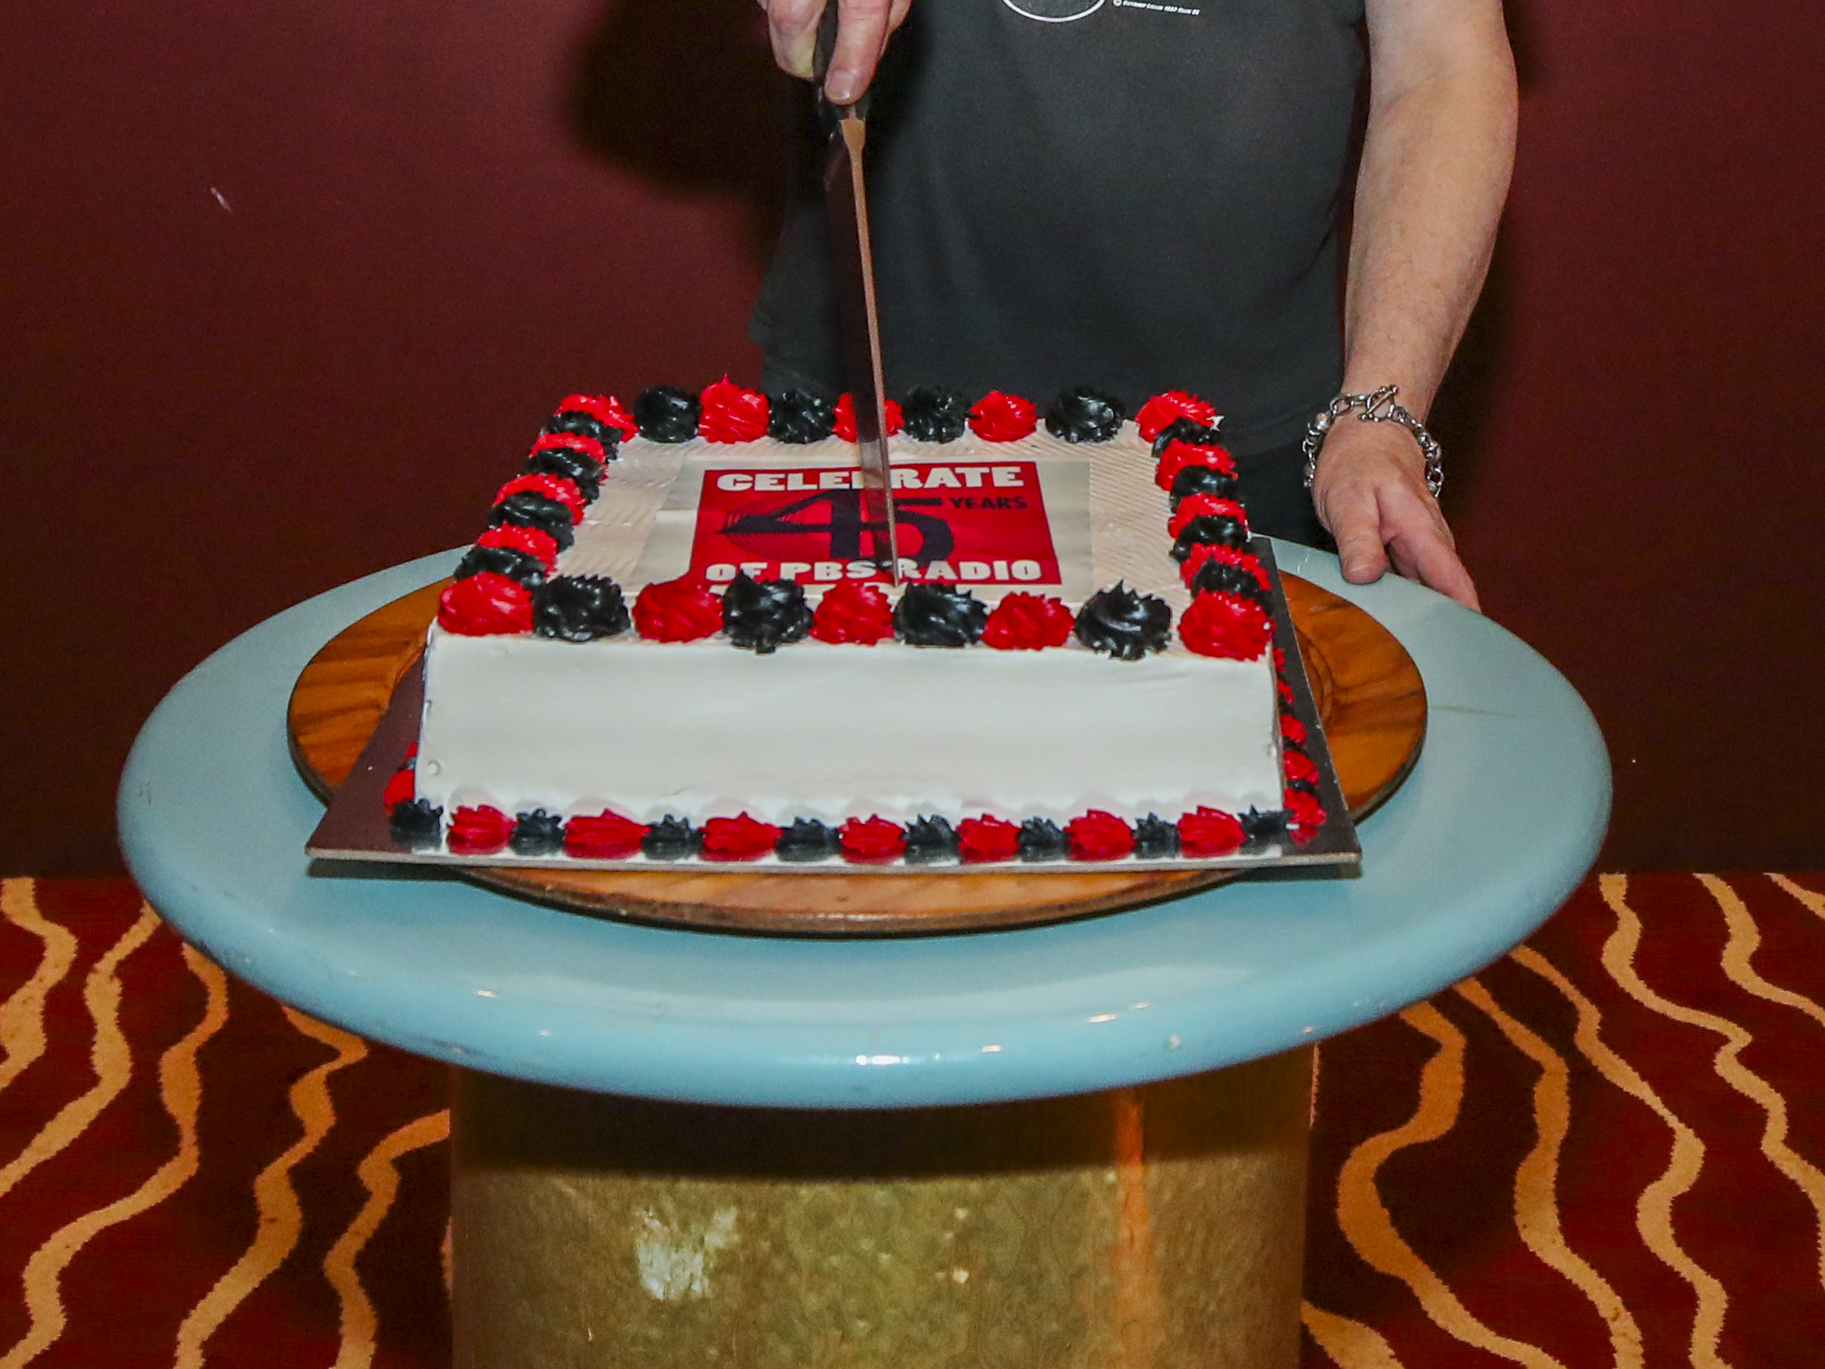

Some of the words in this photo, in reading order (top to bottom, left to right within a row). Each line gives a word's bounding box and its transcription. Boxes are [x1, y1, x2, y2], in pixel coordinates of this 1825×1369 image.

[716, 488, 955, 568] 45
[949, 496, 1027, 509] YEARS
[706, 562, 768, 582] OF
[780, 560, 877, 581] PBS
[896, 558, 1042, 581] RADIO
